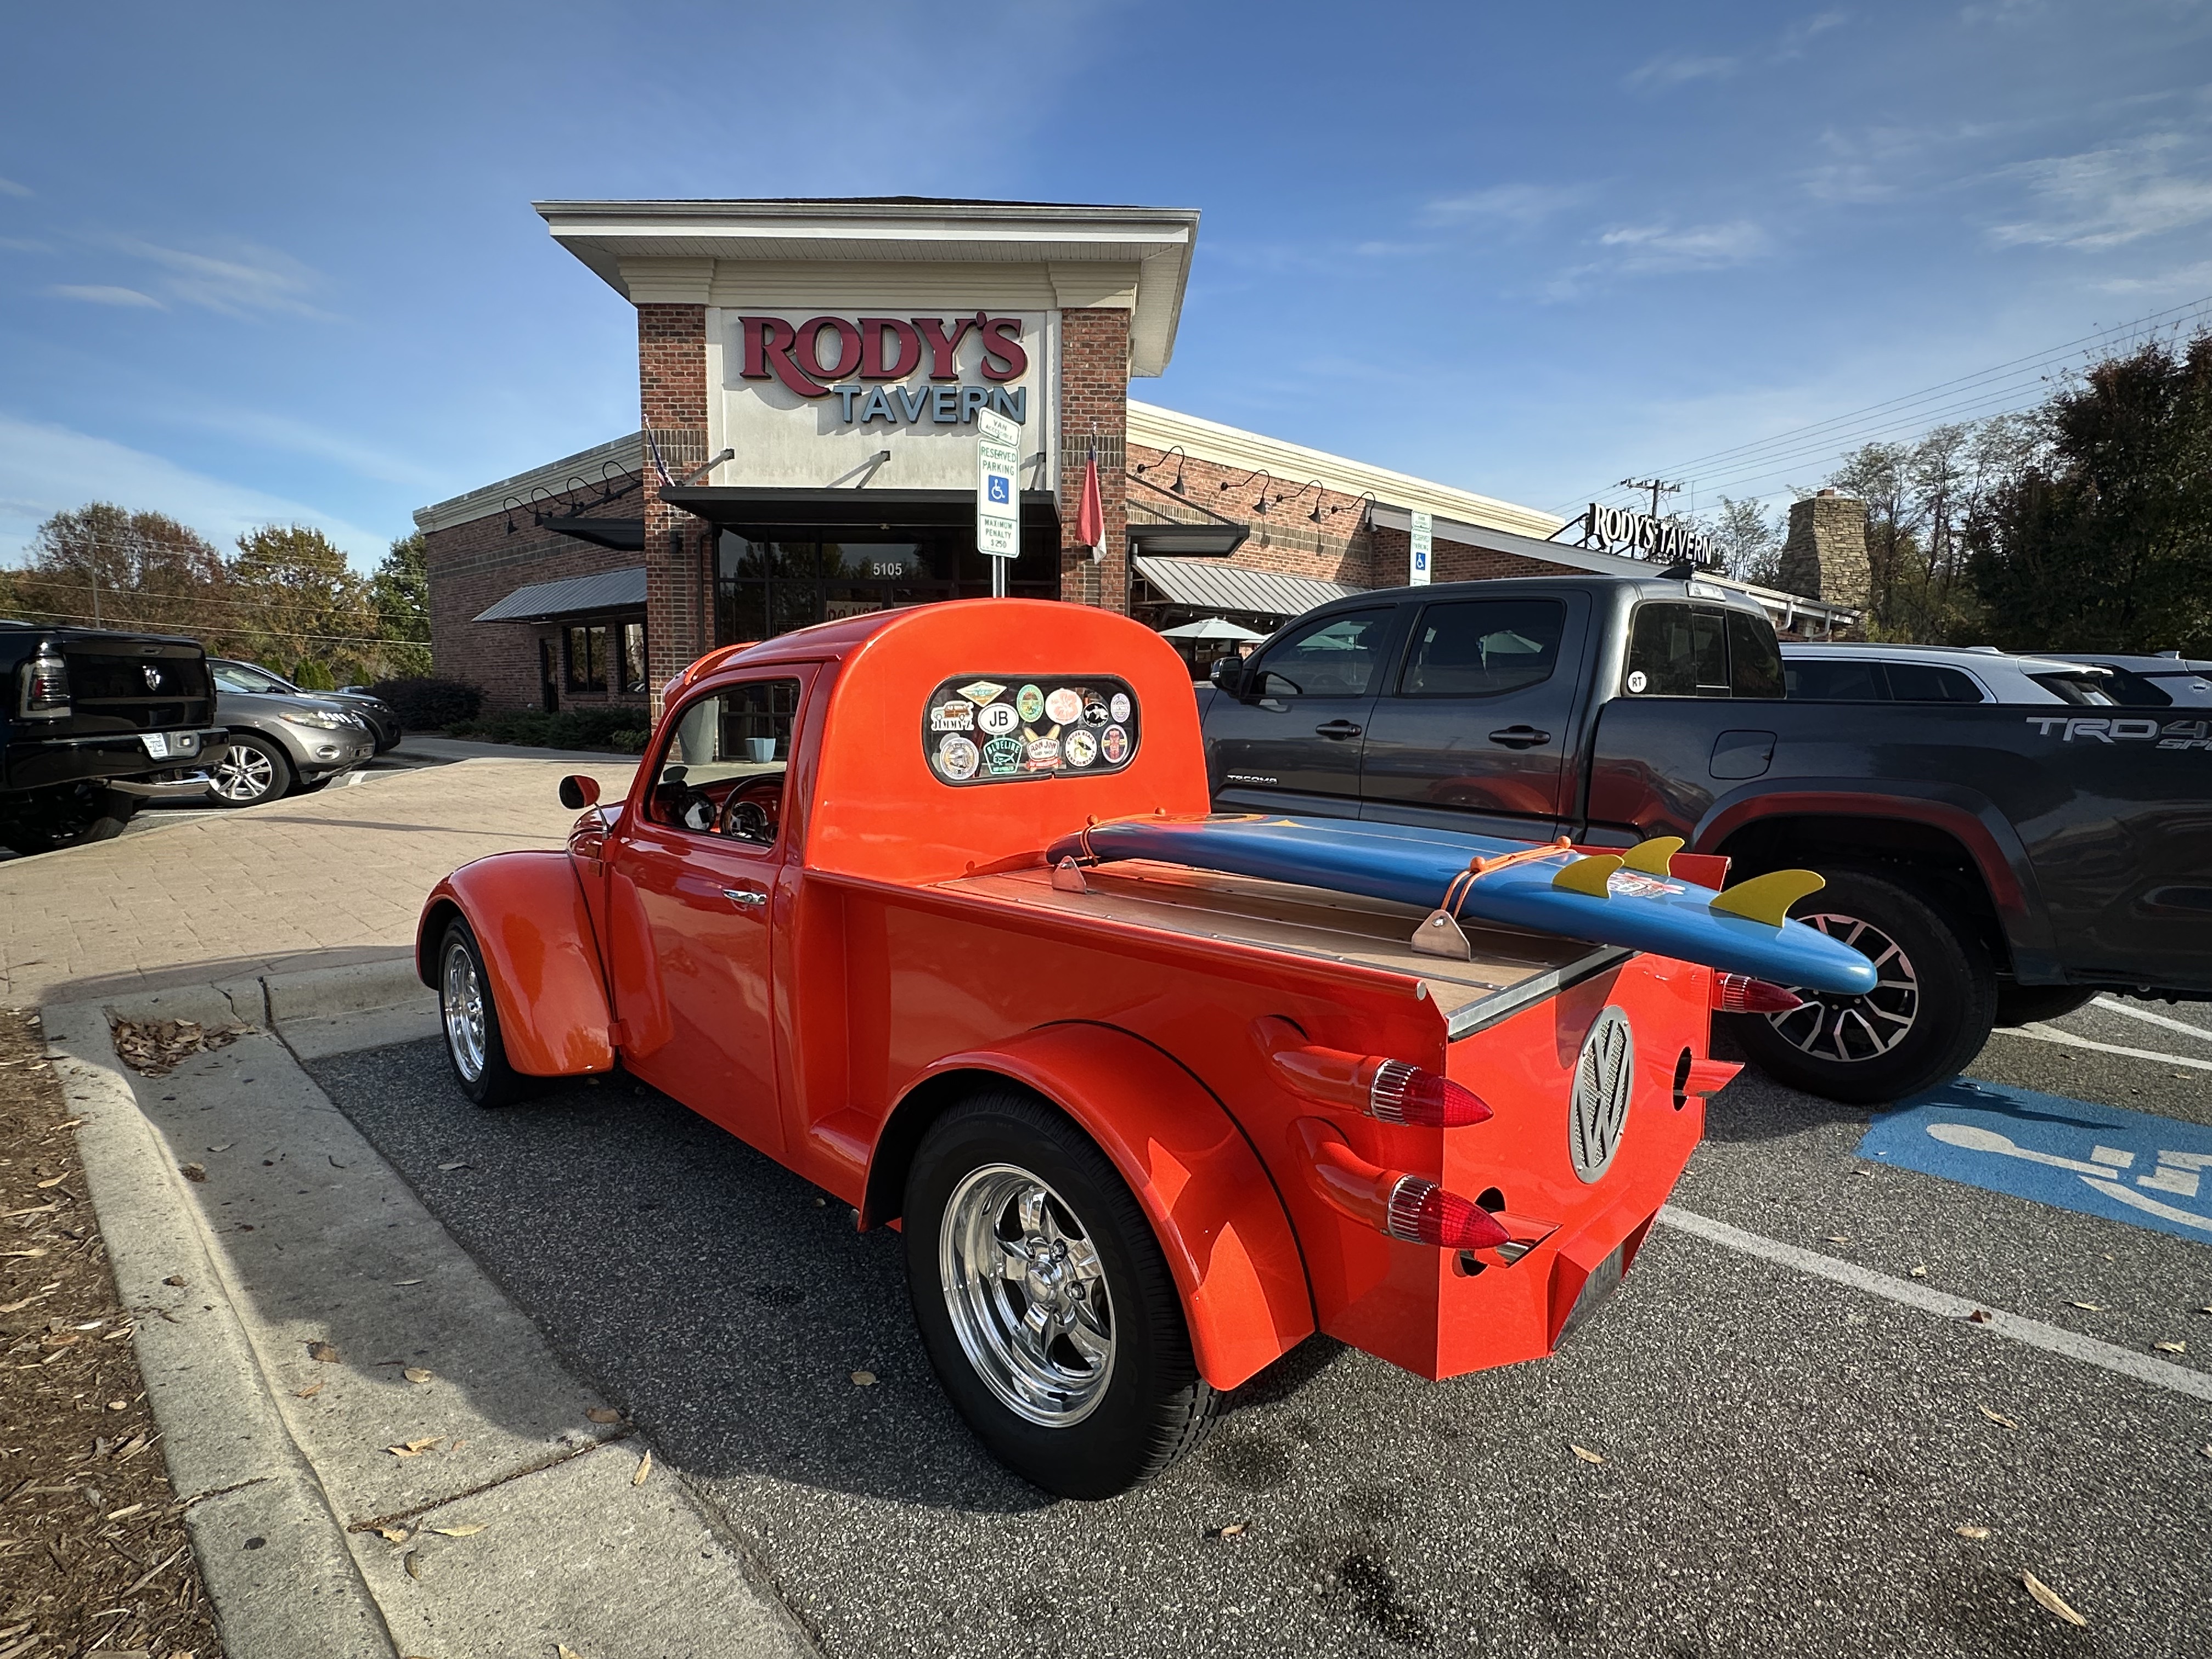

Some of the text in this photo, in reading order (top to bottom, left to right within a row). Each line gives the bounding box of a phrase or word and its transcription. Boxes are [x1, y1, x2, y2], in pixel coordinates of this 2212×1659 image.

[737, 311, 1028, 398] RODY'S
[834, 386, 1026, 425] TAVERN
[994, 419, 1007, 431] VAN
[981, 446, 1016, 462] RESERVED
[983, 460, 1014, 476] PARKING
[985, 518, 1012, 529] MAXIMUM
[985, 528, 1011, 539] PENALTY
[1589, 503, 1713, 565] RODY'S TAVERN
[991, 540, 1007, 549] $250
[873, 563, 902, 575] 5105
[1632, 676, 1643, 687] RT
[989, 711, 1008, 726] JB
[2026, 716, 2160, 744] TRD
[987, 741, 1020, 754] BLUELINE
[1031, 741, 1043, 752] RON
